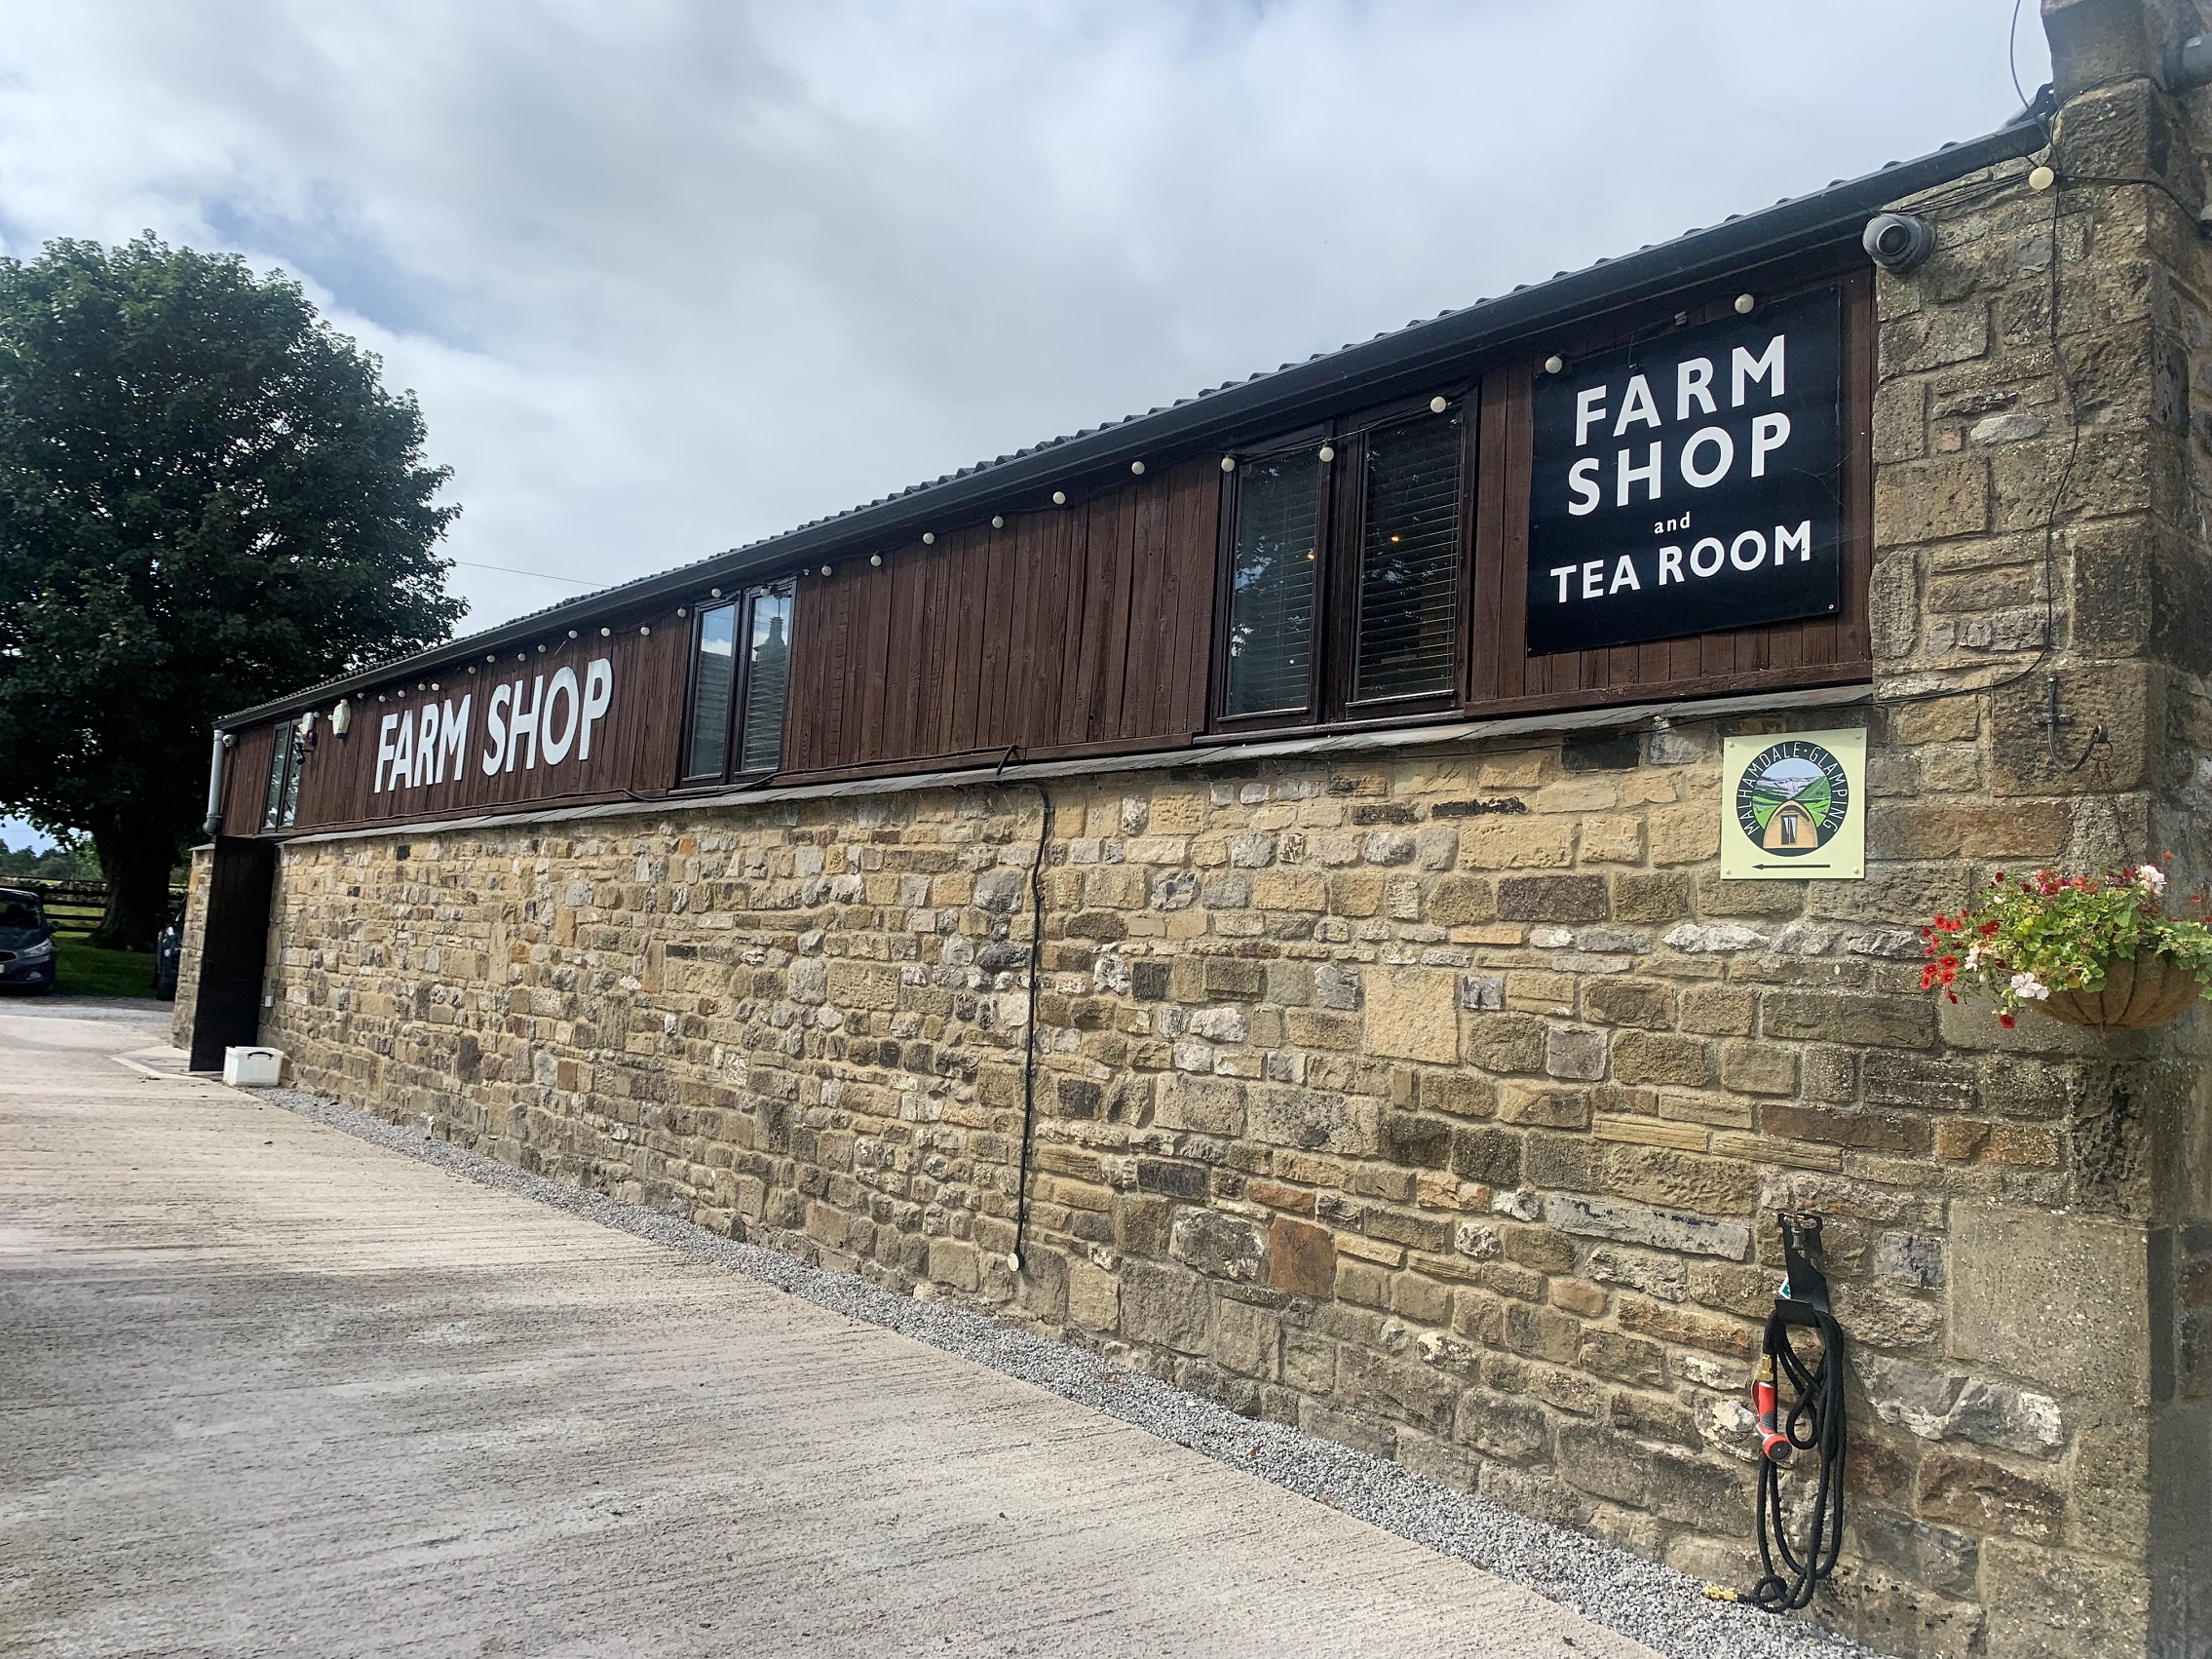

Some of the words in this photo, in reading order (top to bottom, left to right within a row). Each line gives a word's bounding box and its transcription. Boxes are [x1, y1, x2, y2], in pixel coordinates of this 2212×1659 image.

[1575, 334, 1785, 446] FARM
[1568, 412, 1791, 516] SHOP
[1550, 555, 1641, 603] TEA
[1659, 520, 1811, 585] ROOM
[1654, 512, 1691, 534] and
[374, 694, 471, 793] FARM
[482, 658, 612, 776] SHOP
[1737, 743, 1801, 835] MALHAMDALE
[1810, 747, 1848, 832] GLAMPING
